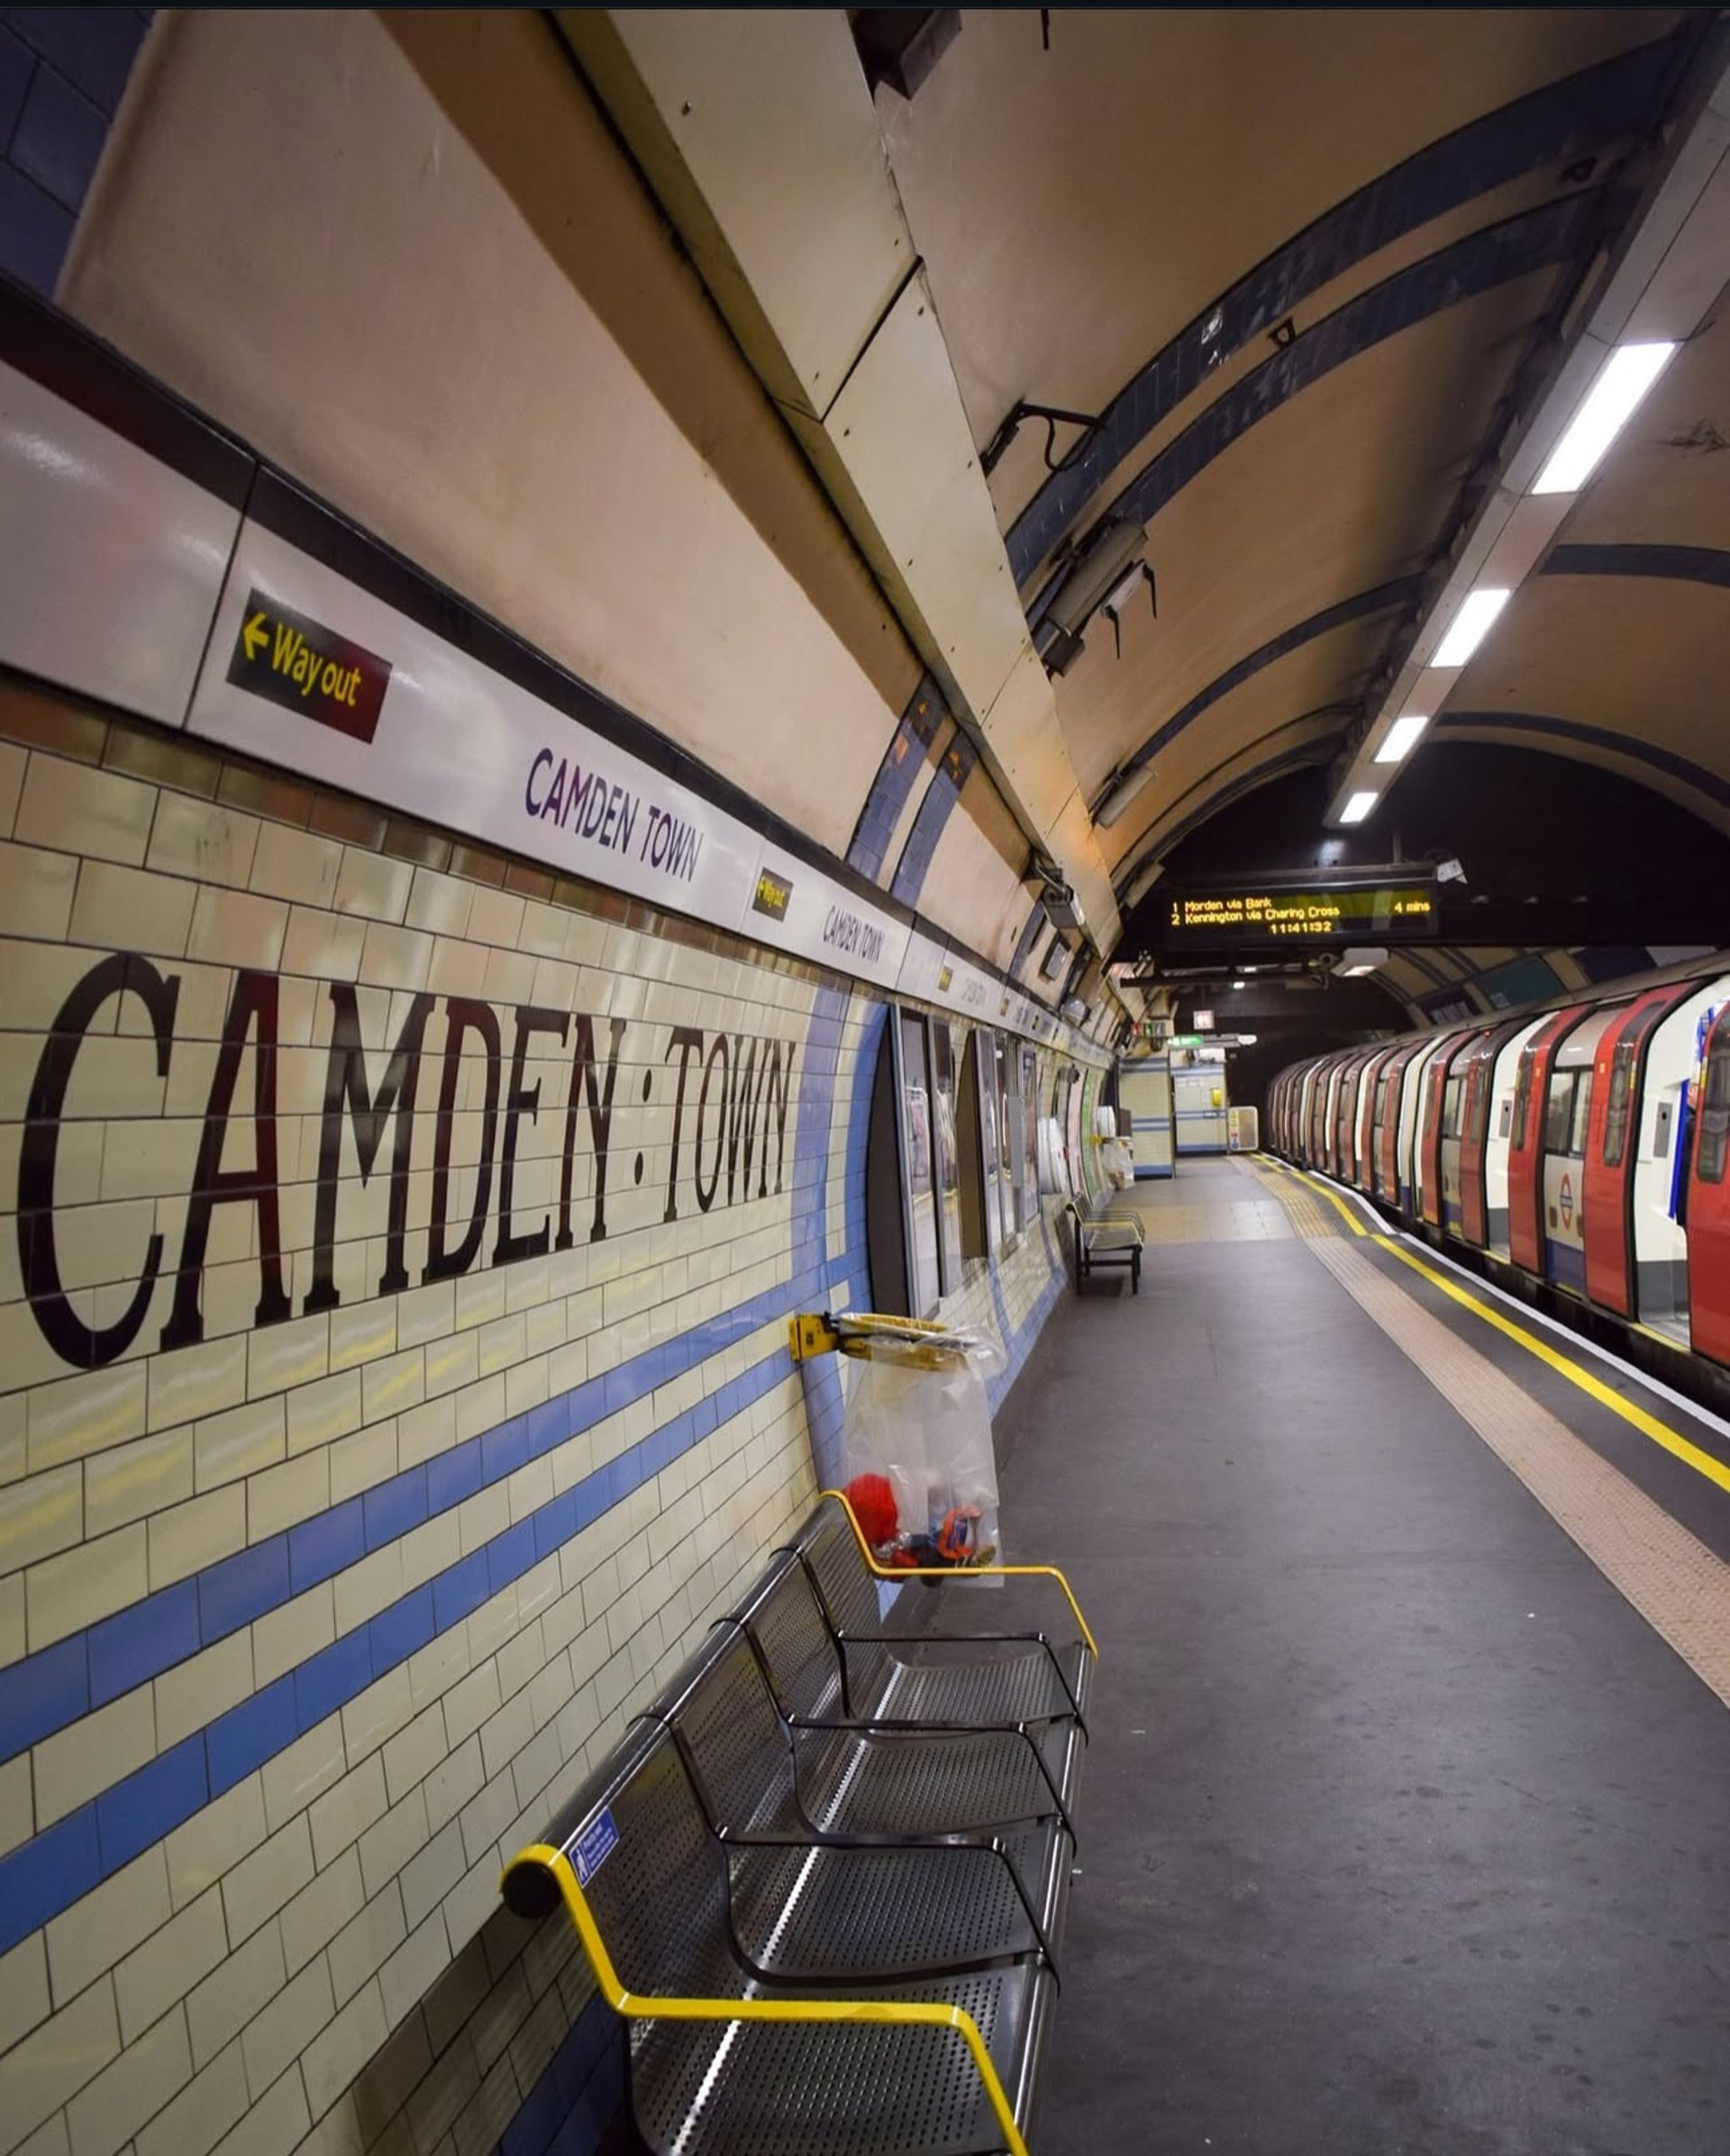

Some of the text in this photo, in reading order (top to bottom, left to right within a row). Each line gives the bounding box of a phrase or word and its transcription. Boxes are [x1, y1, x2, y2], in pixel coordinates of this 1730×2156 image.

[272, 621, 362, 707] Way out
[525, 747, 705, 883] CAMDEN TOWN
[1171, 901, 1431, 925] 2 Kennington via Charing Cross 4 mins
[1172, 897, 1271, 913] 1 Morden via Bank
[16, 951, 627, 1374] CAMDEN
[663, 1025, 797, 1224] TOWN
